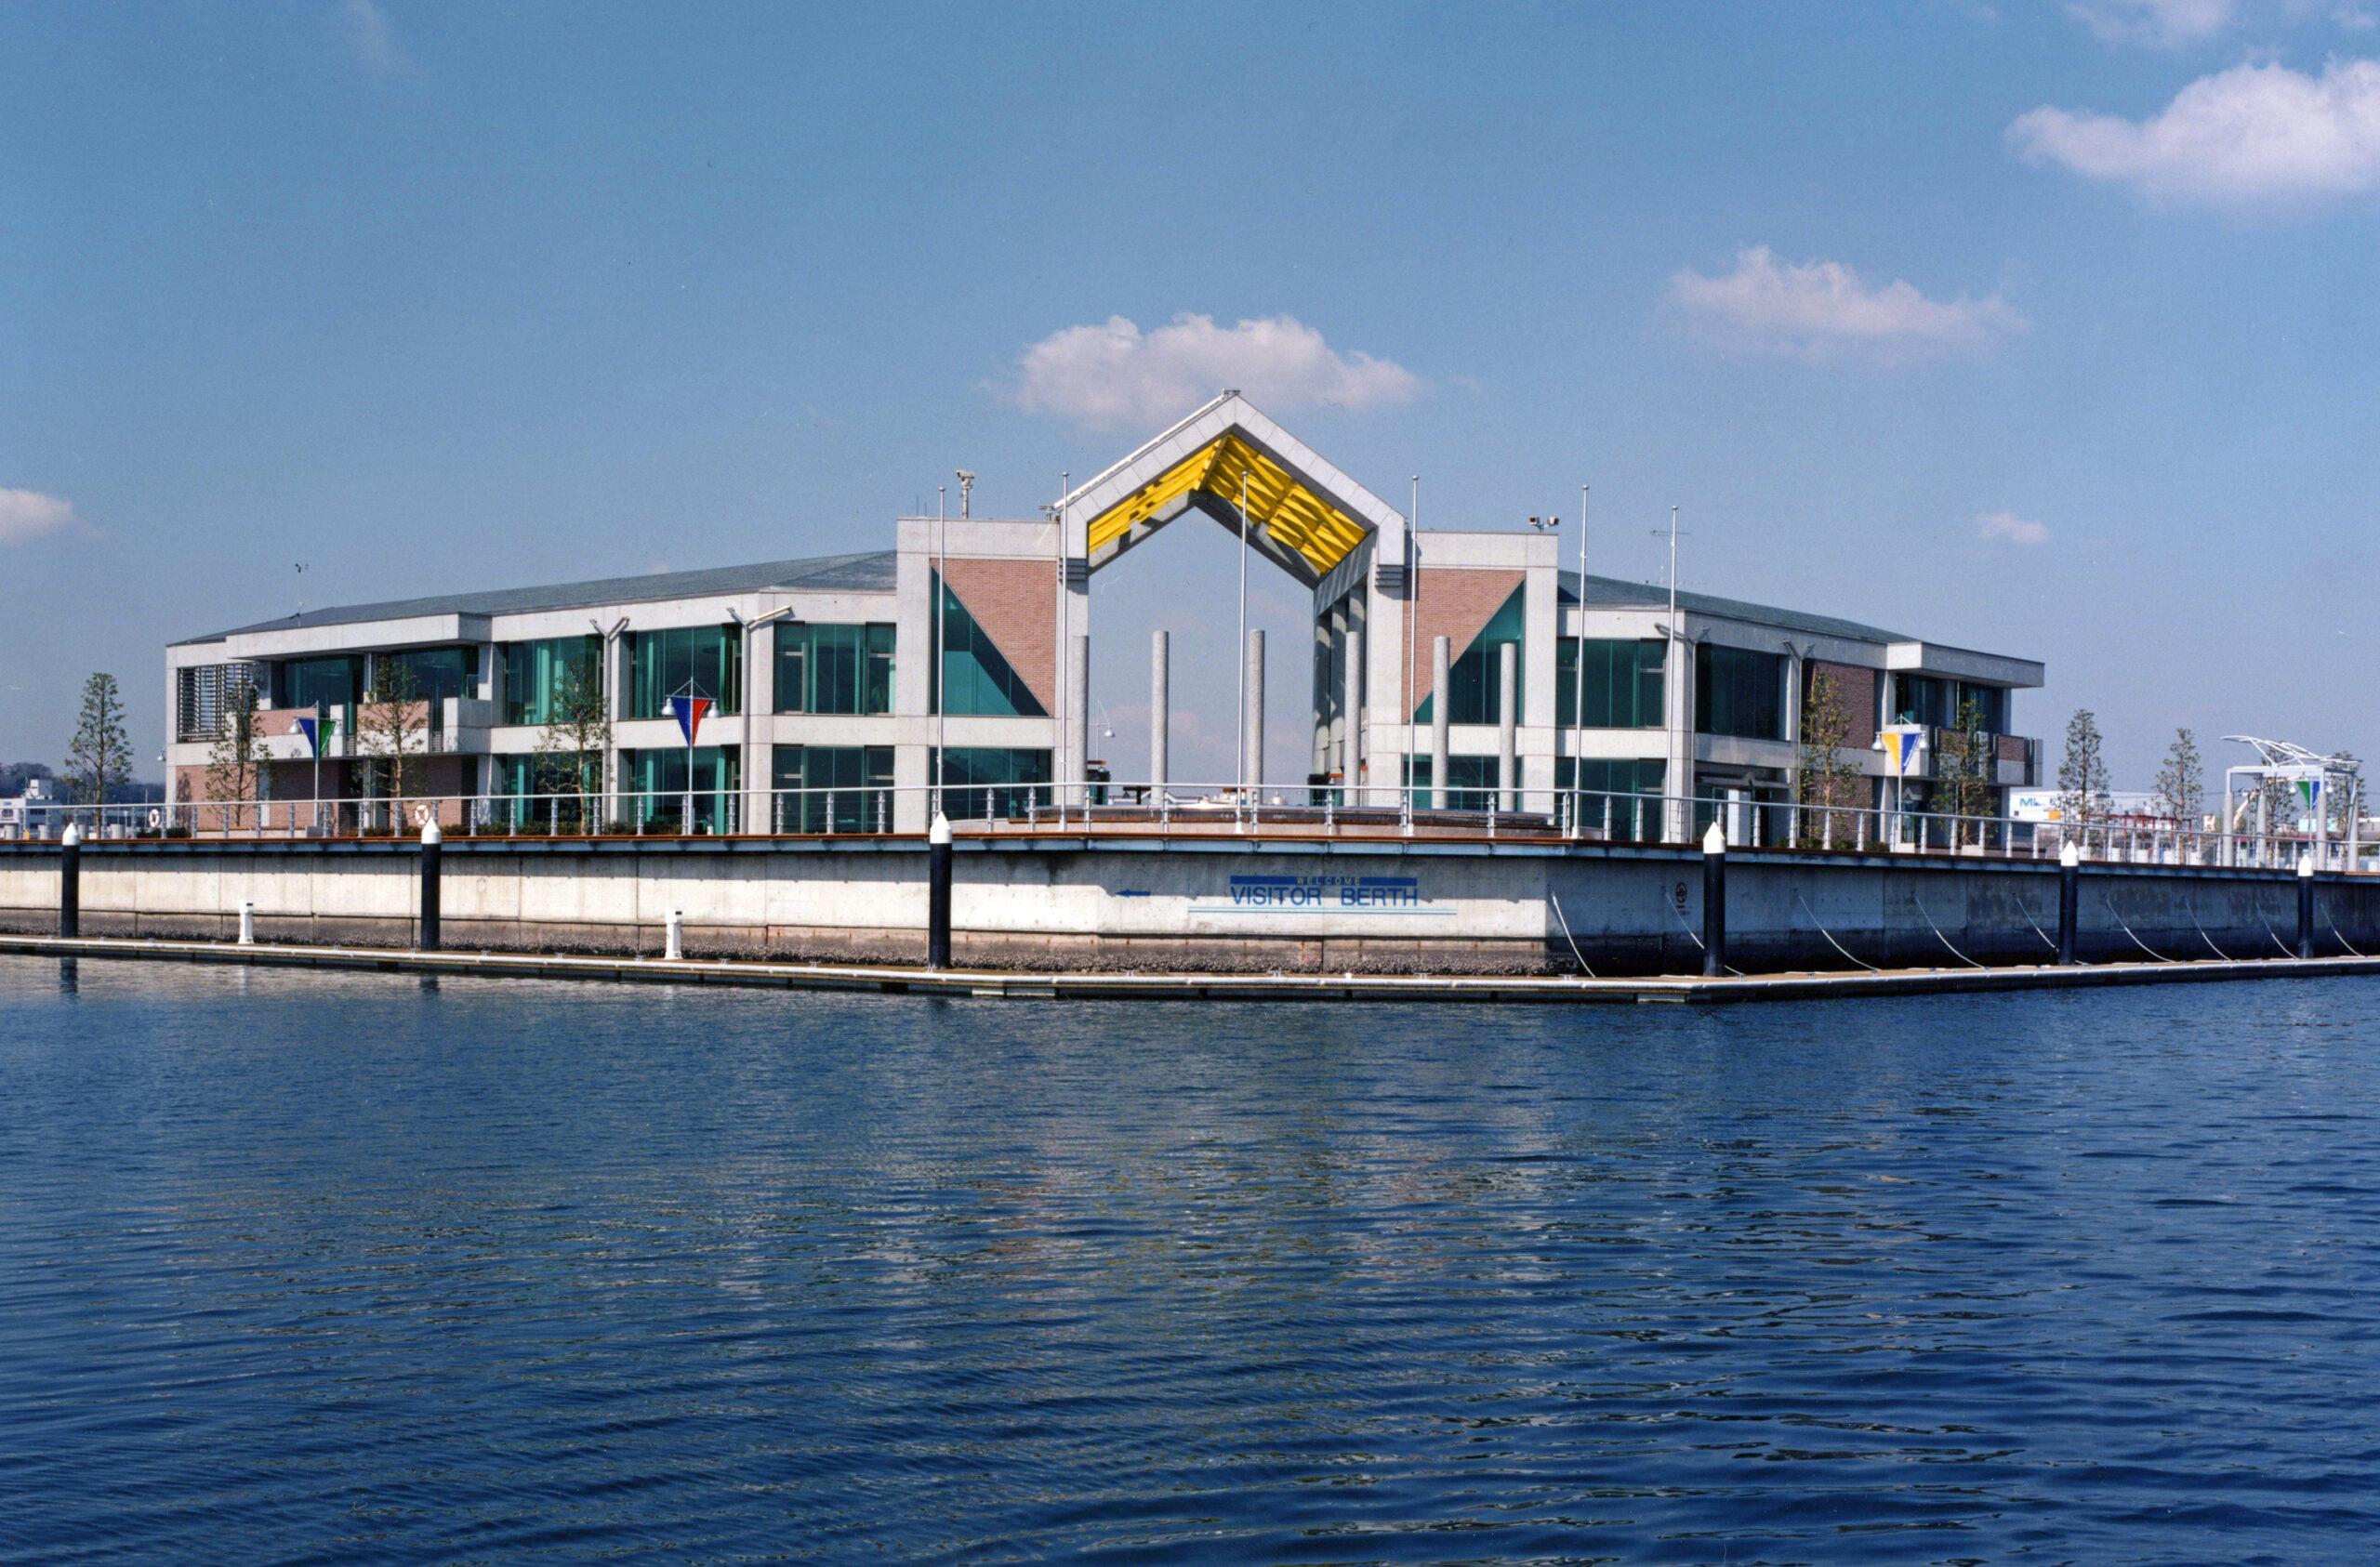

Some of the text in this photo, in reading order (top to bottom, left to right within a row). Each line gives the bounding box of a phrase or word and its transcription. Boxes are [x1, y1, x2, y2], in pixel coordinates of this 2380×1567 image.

[1297, 876, 1361, 886] WELCOME
[1230, 887, 1418, 906] VISITOR BERTH
